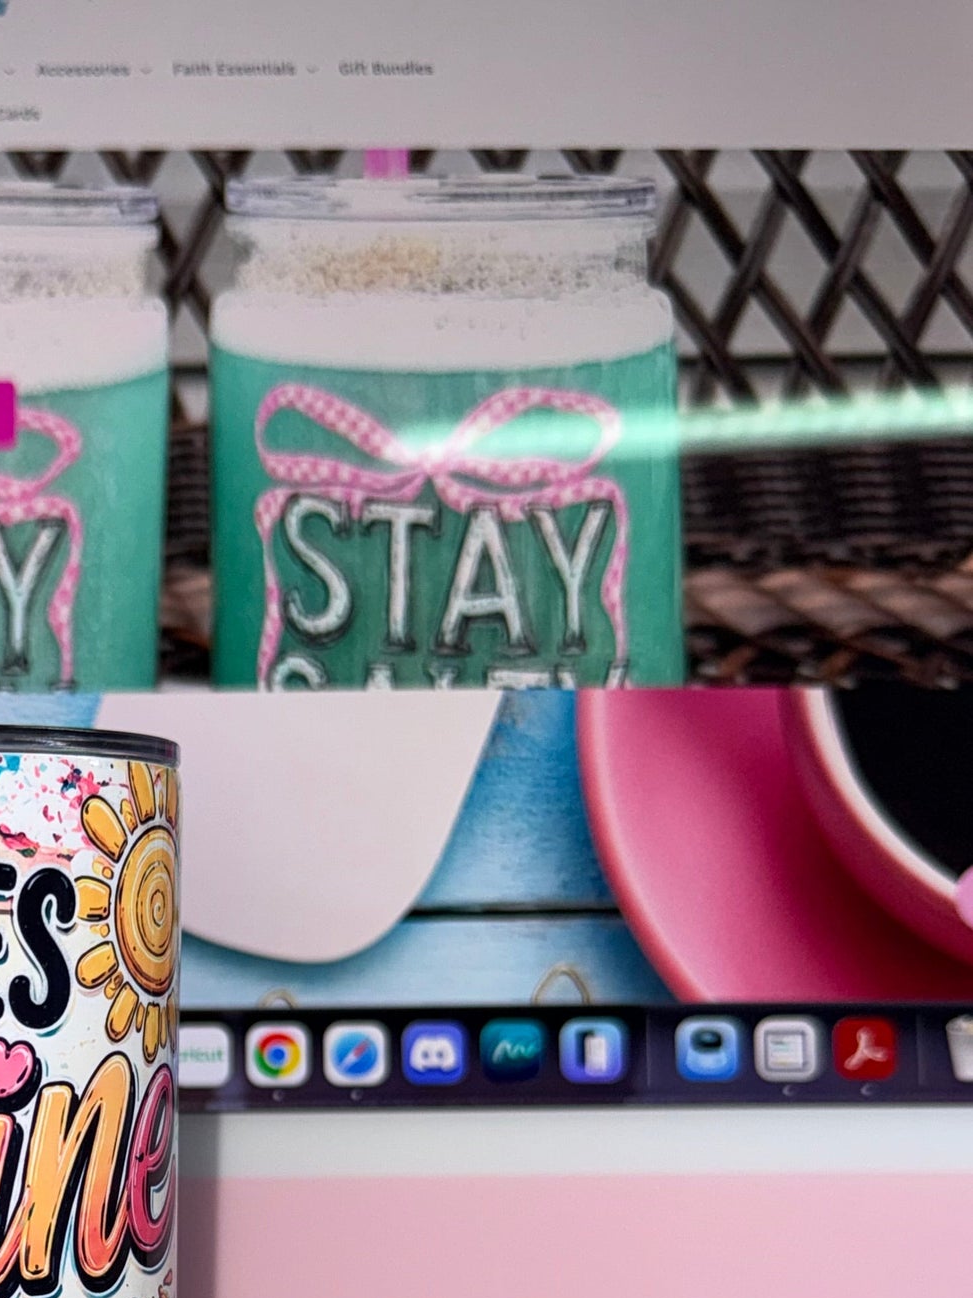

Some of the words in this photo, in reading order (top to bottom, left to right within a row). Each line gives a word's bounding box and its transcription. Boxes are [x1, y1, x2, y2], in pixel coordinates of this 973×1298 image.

[36, 63, 130, 78] Accessories
[173, 62, 213, 77] Faith
[216, 62, 297, 77] Essentials
[338, 61, 369, 77] Gift
[371, 61, 435, 77] Bundles
[281, 492, 614, 658] STAY
